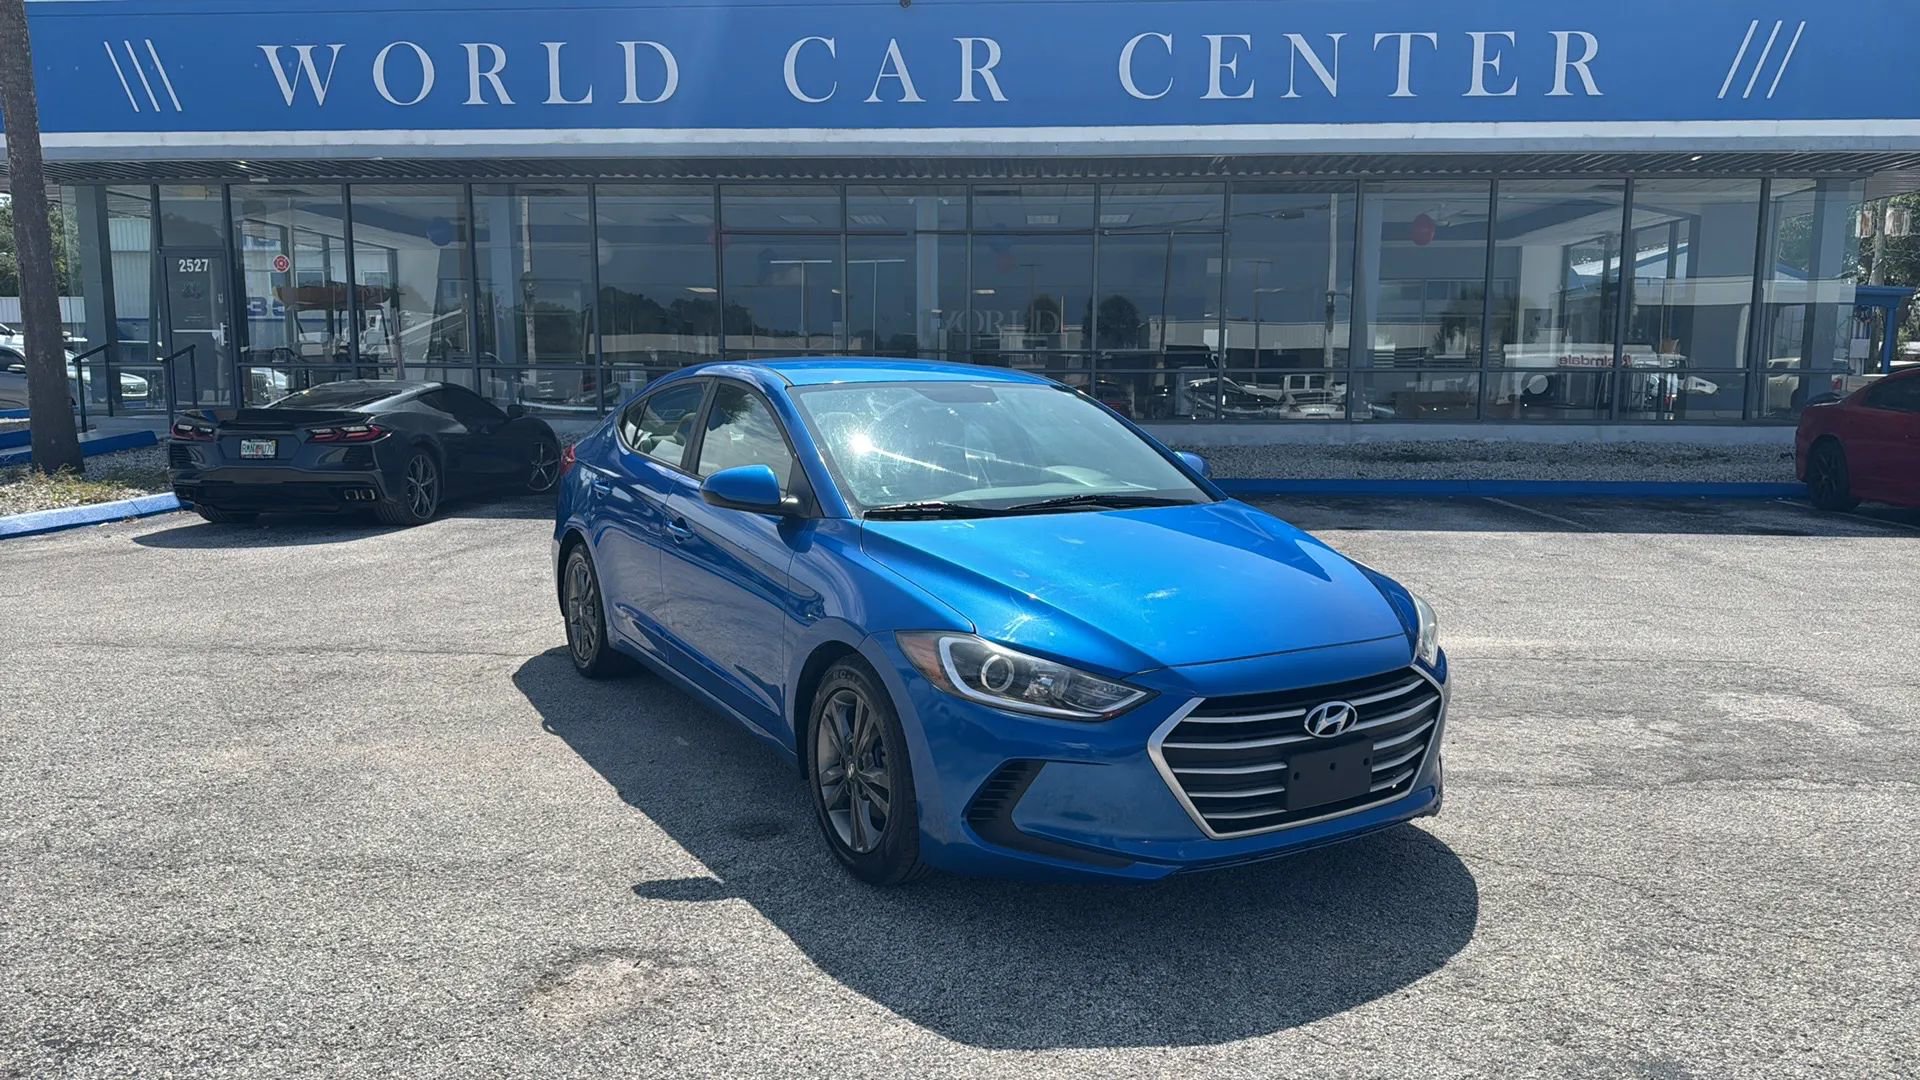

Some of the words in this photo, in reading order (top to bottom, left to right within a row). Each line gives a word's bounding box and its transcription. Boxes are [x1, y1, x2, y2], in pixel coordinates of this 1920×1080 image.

[258, 42, 678, 106] WORLD
[783, 37, 1008, 103] CAR
[1118, 31, 1603, 100] CENTER
[178, 258, 209, 272] 2527
